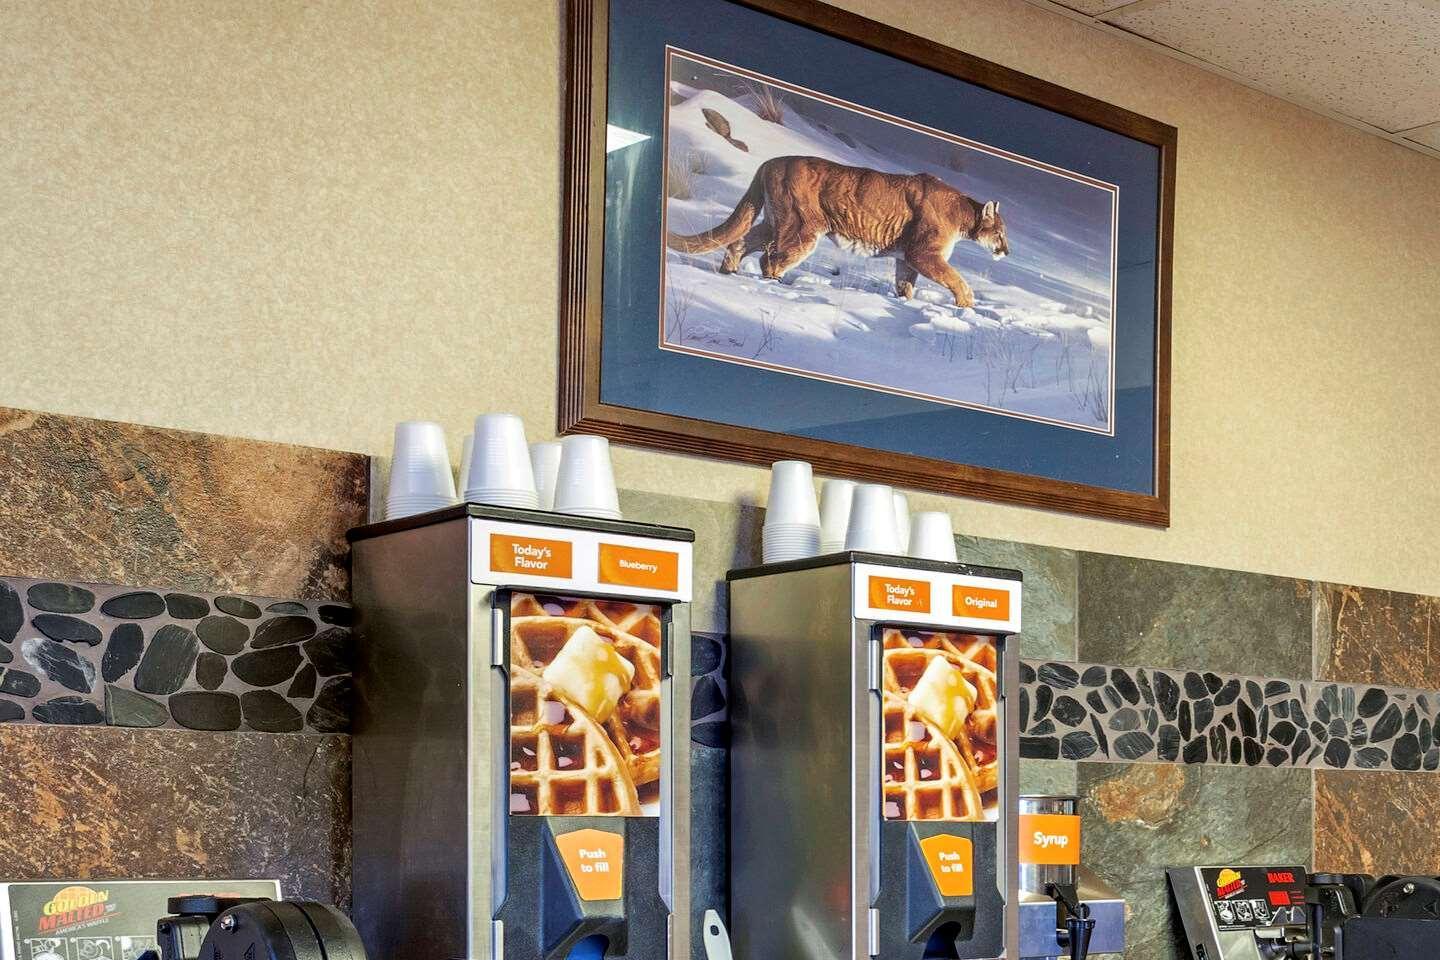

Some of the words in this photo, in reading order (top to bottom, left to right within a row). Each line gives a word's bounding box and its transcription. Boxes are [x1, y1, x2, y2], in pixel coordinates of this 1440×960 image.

[512, 543, 551, 560] Today's
[514, 557, 548, 569] Flavor
[618, 559, 658, 574] Blueberry
[884, 583, 915, 597] Today's
[887, 594, 912, 606] Flavor
[964, 596, 997, 609] Original
[1033, 831, 1068, 848] Syrup
[578, 847, 606, 859] Push
[938, 851, 960, 861] Push
[581, 863, 593, 873] to
[595, 861, 609, 873] fill
[941, 864, 950, 873] to
[950, 863, 963, 873] fill
[39, 903, 105, 931] MALTED
